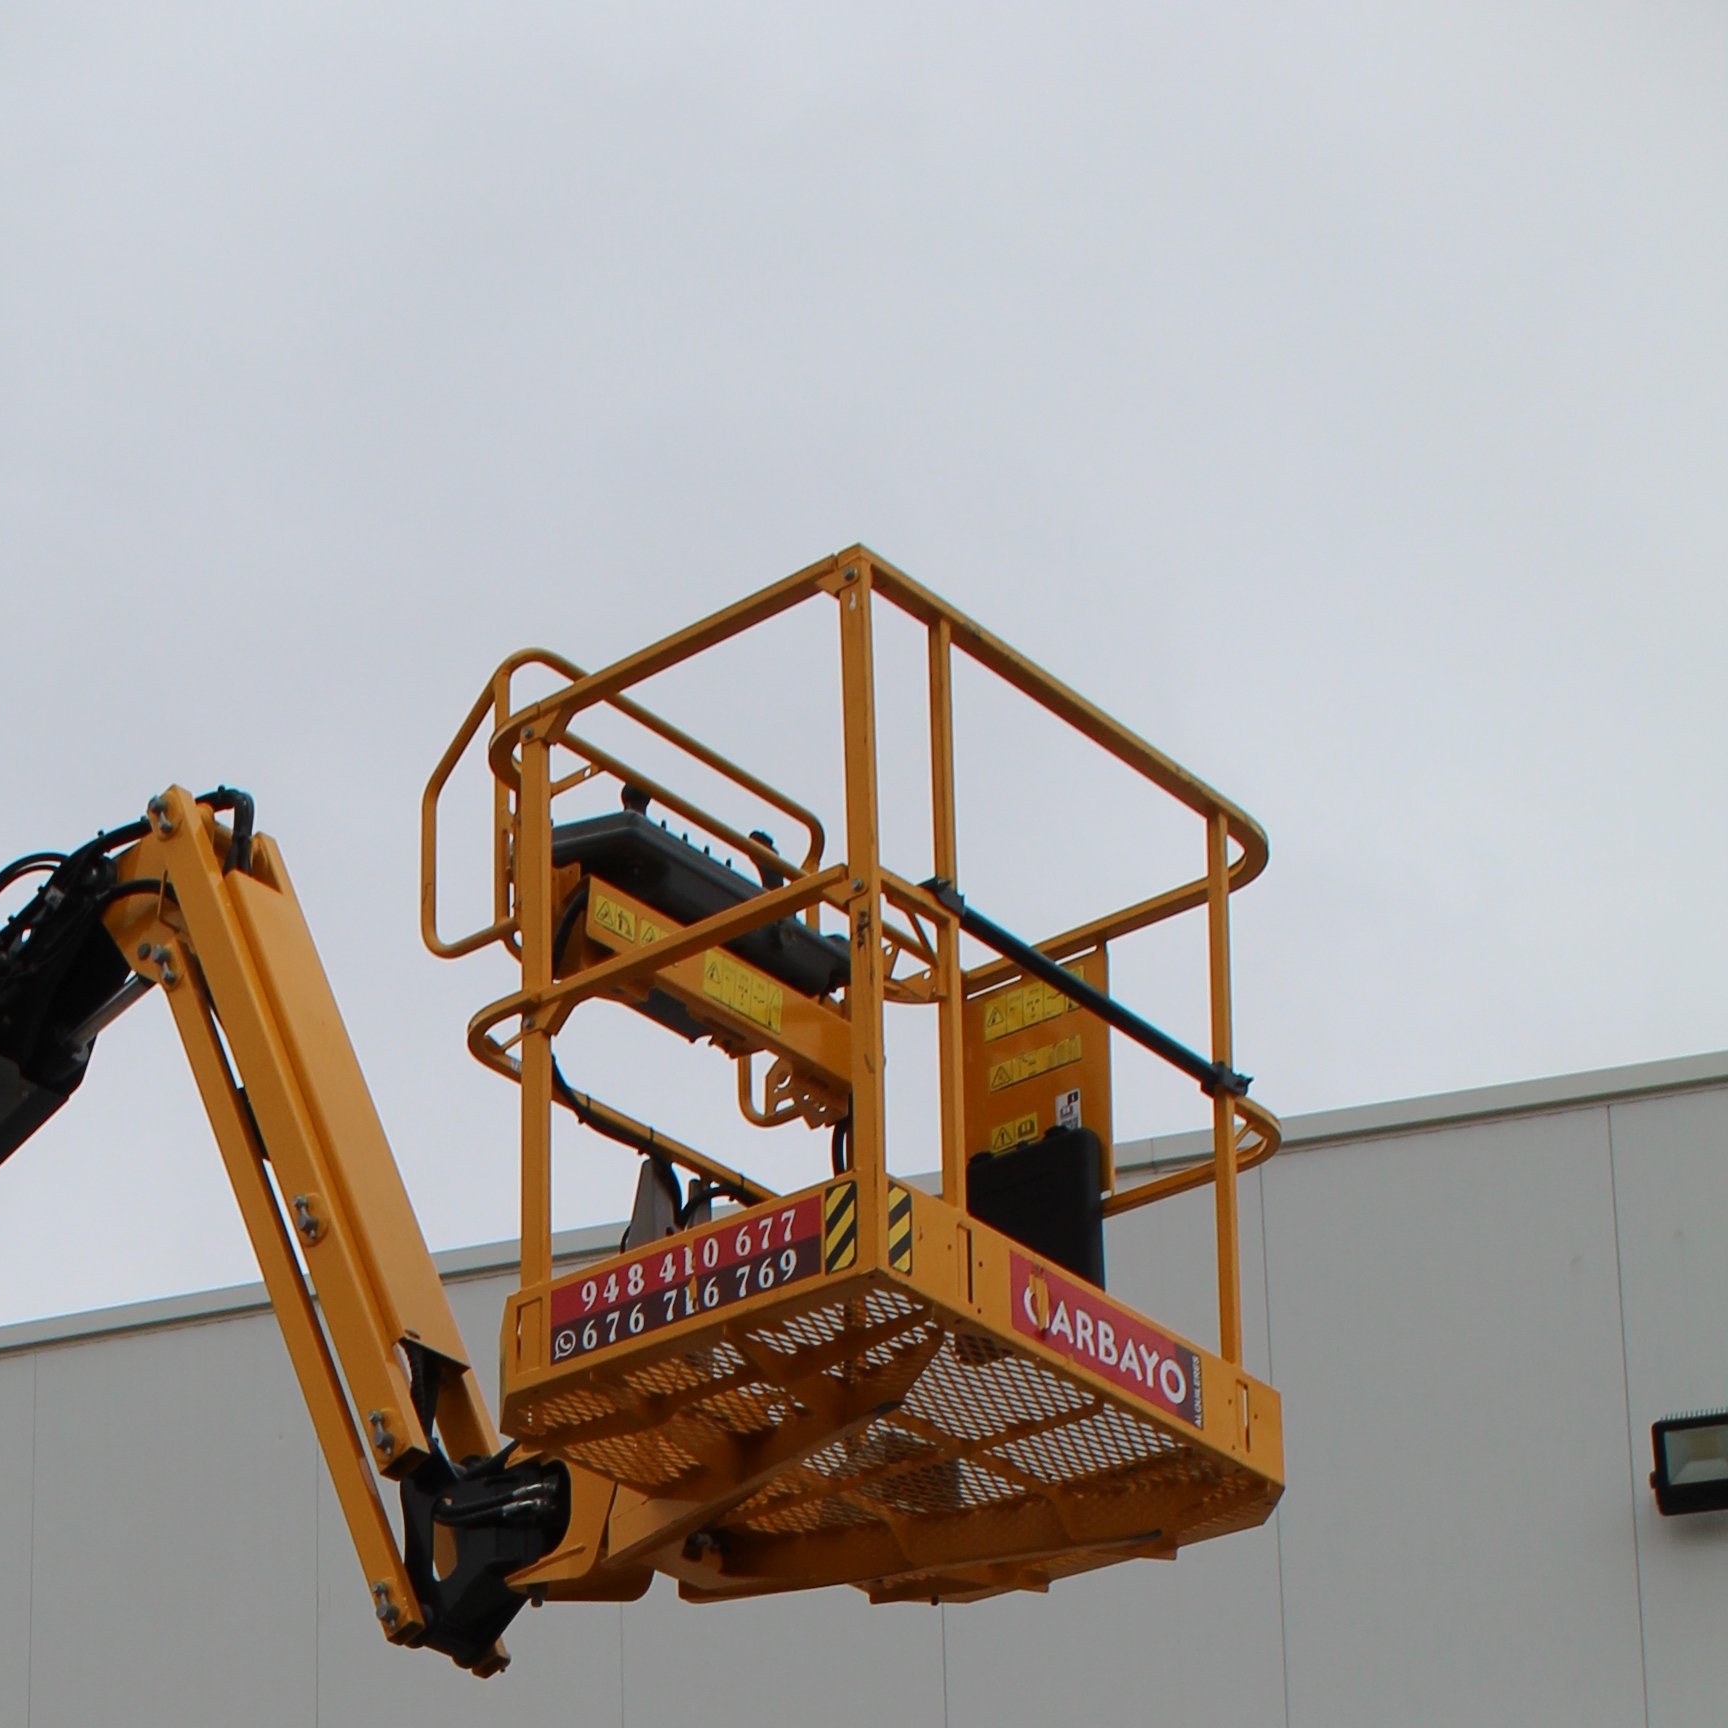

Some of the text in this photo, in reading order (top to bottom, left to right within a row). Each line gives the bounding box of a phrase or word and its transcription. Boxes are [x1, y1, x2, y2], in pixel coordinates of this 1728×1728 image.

[581, 1208, 797, 1311] 948 410 677
[582, 1249, 798, 1351] 676 716 769
